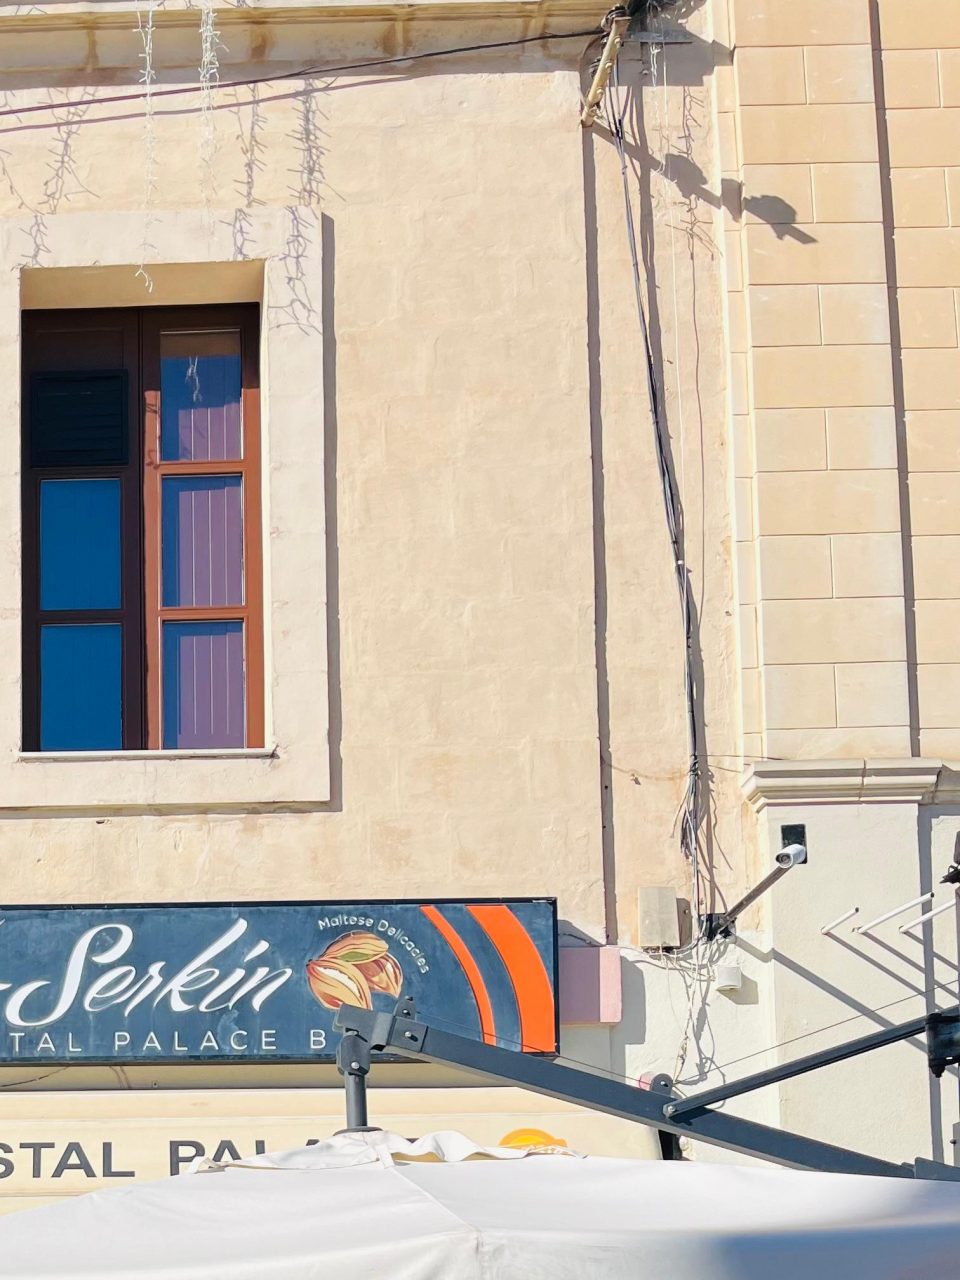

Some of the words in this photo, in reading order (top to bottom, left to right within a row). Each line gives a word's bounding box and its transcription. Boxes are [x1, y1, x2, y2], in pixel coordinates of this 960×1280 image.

[318, 914, 374, 930] Maltese
[377, 920, 429, 974] Delicacies
[114, 1030, 277, 1052] PALACE
